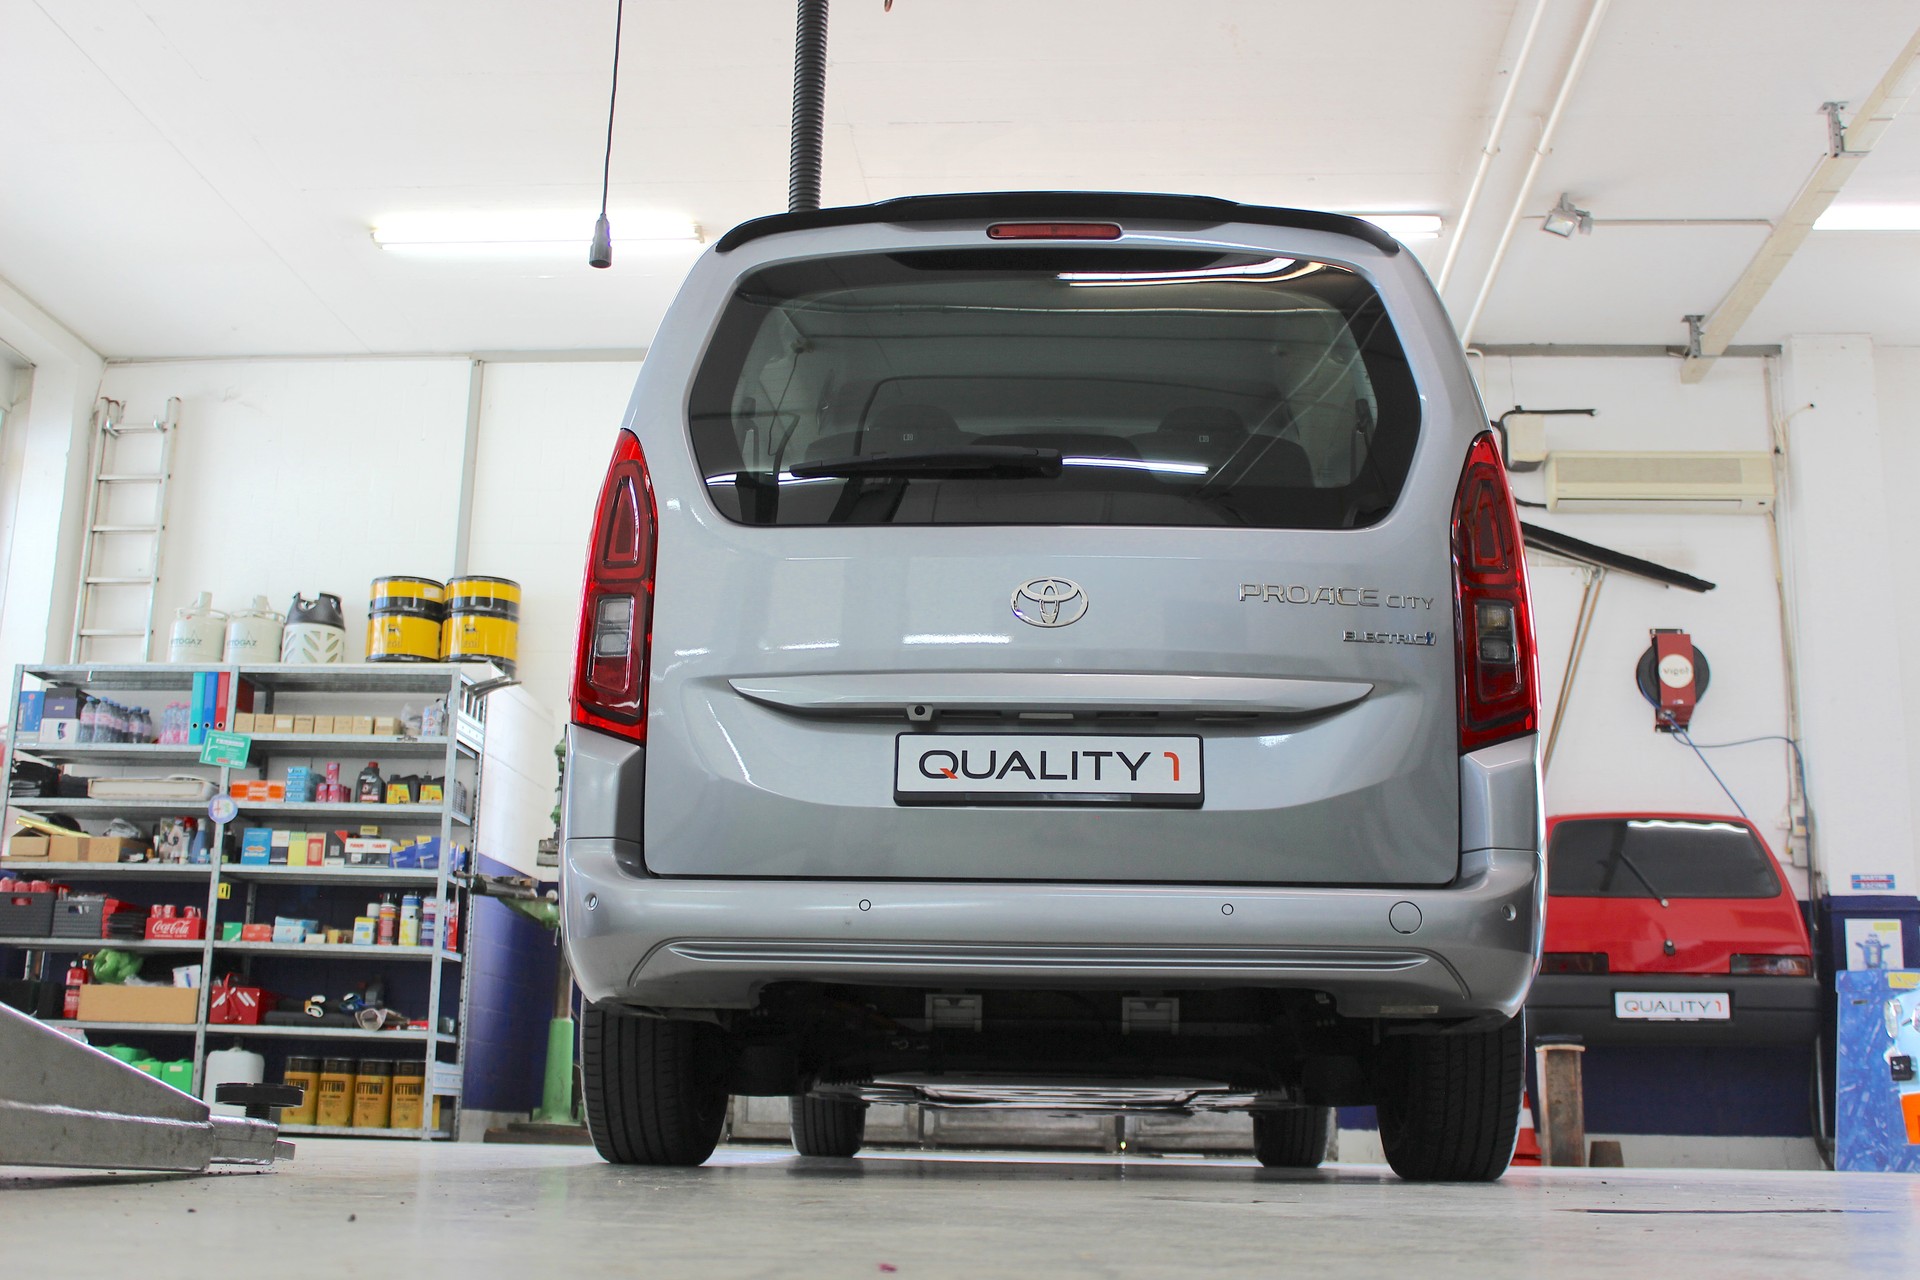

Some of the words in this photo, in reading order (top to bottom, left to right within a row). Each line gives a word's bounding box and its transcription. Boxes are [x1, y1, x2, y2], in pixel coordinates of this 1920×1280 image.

[1239, 583, 1380, 607] PROACE
[1386, 594, 1434, 609] CITY
[1343, 629, 1427, 644] ELECTRIC
[918, 749, 1152, 781] QUALITY
[1163, 751, 1180, 782] 1
[1624, 1000, 1711, 1013] QUALITY
[1715, 1000, 1722, 1012] 1
